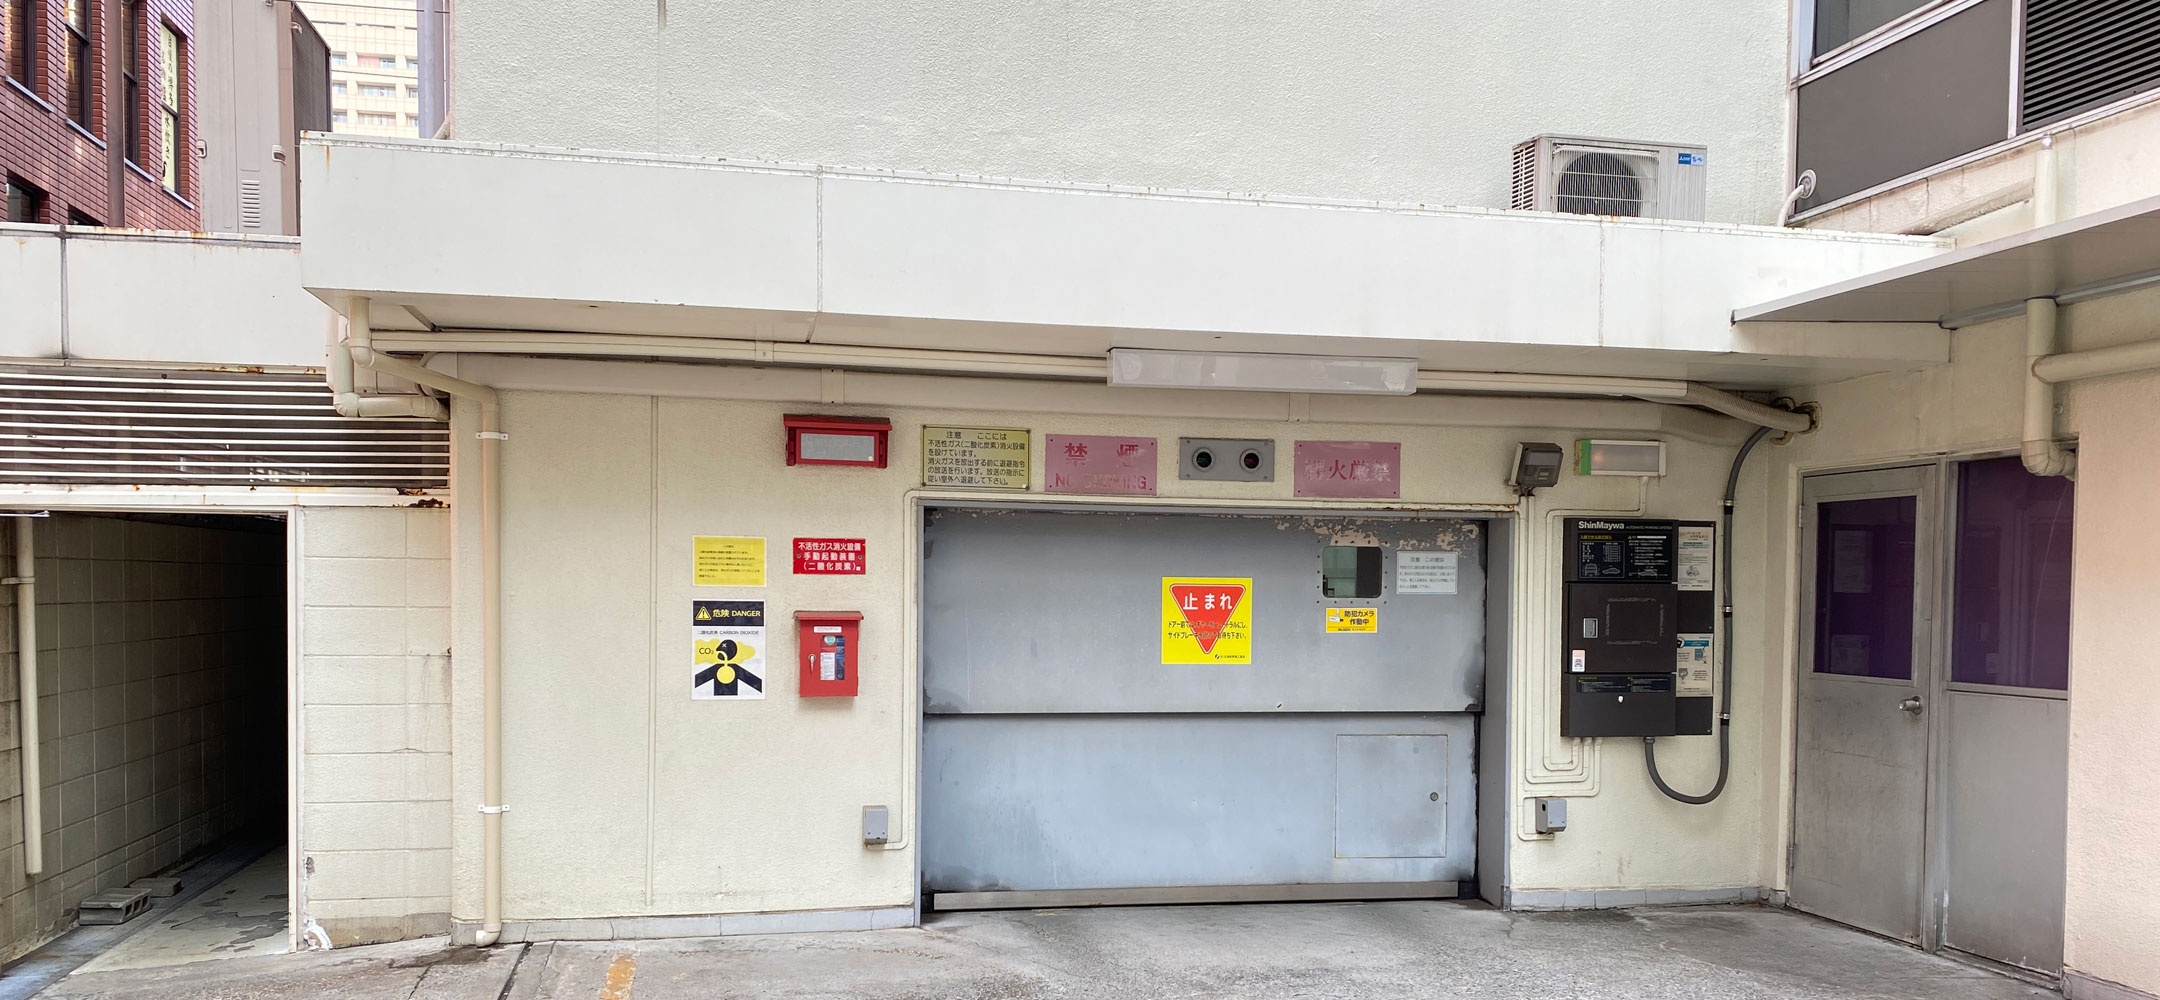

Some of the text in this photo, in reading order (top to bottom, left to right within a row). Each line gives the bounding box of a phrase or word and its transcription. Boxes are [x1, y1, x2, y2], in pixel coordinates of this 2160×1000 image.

[946, 431, 1007, 440] 注意 ここには
[1578, 521, 1625, 530] ShinMaywa
[798, 542, 861, 551] 不活性ガス消火設備
[804, 552, 856, 561] 手動起動装置
[1182, 592, 1233, 611] 止まれ
[712, 608, 730, 617] 危険
[1344, 610, 1375, 618] 防犯カメラ
[1349, 618, 1370, 626] 作動中
